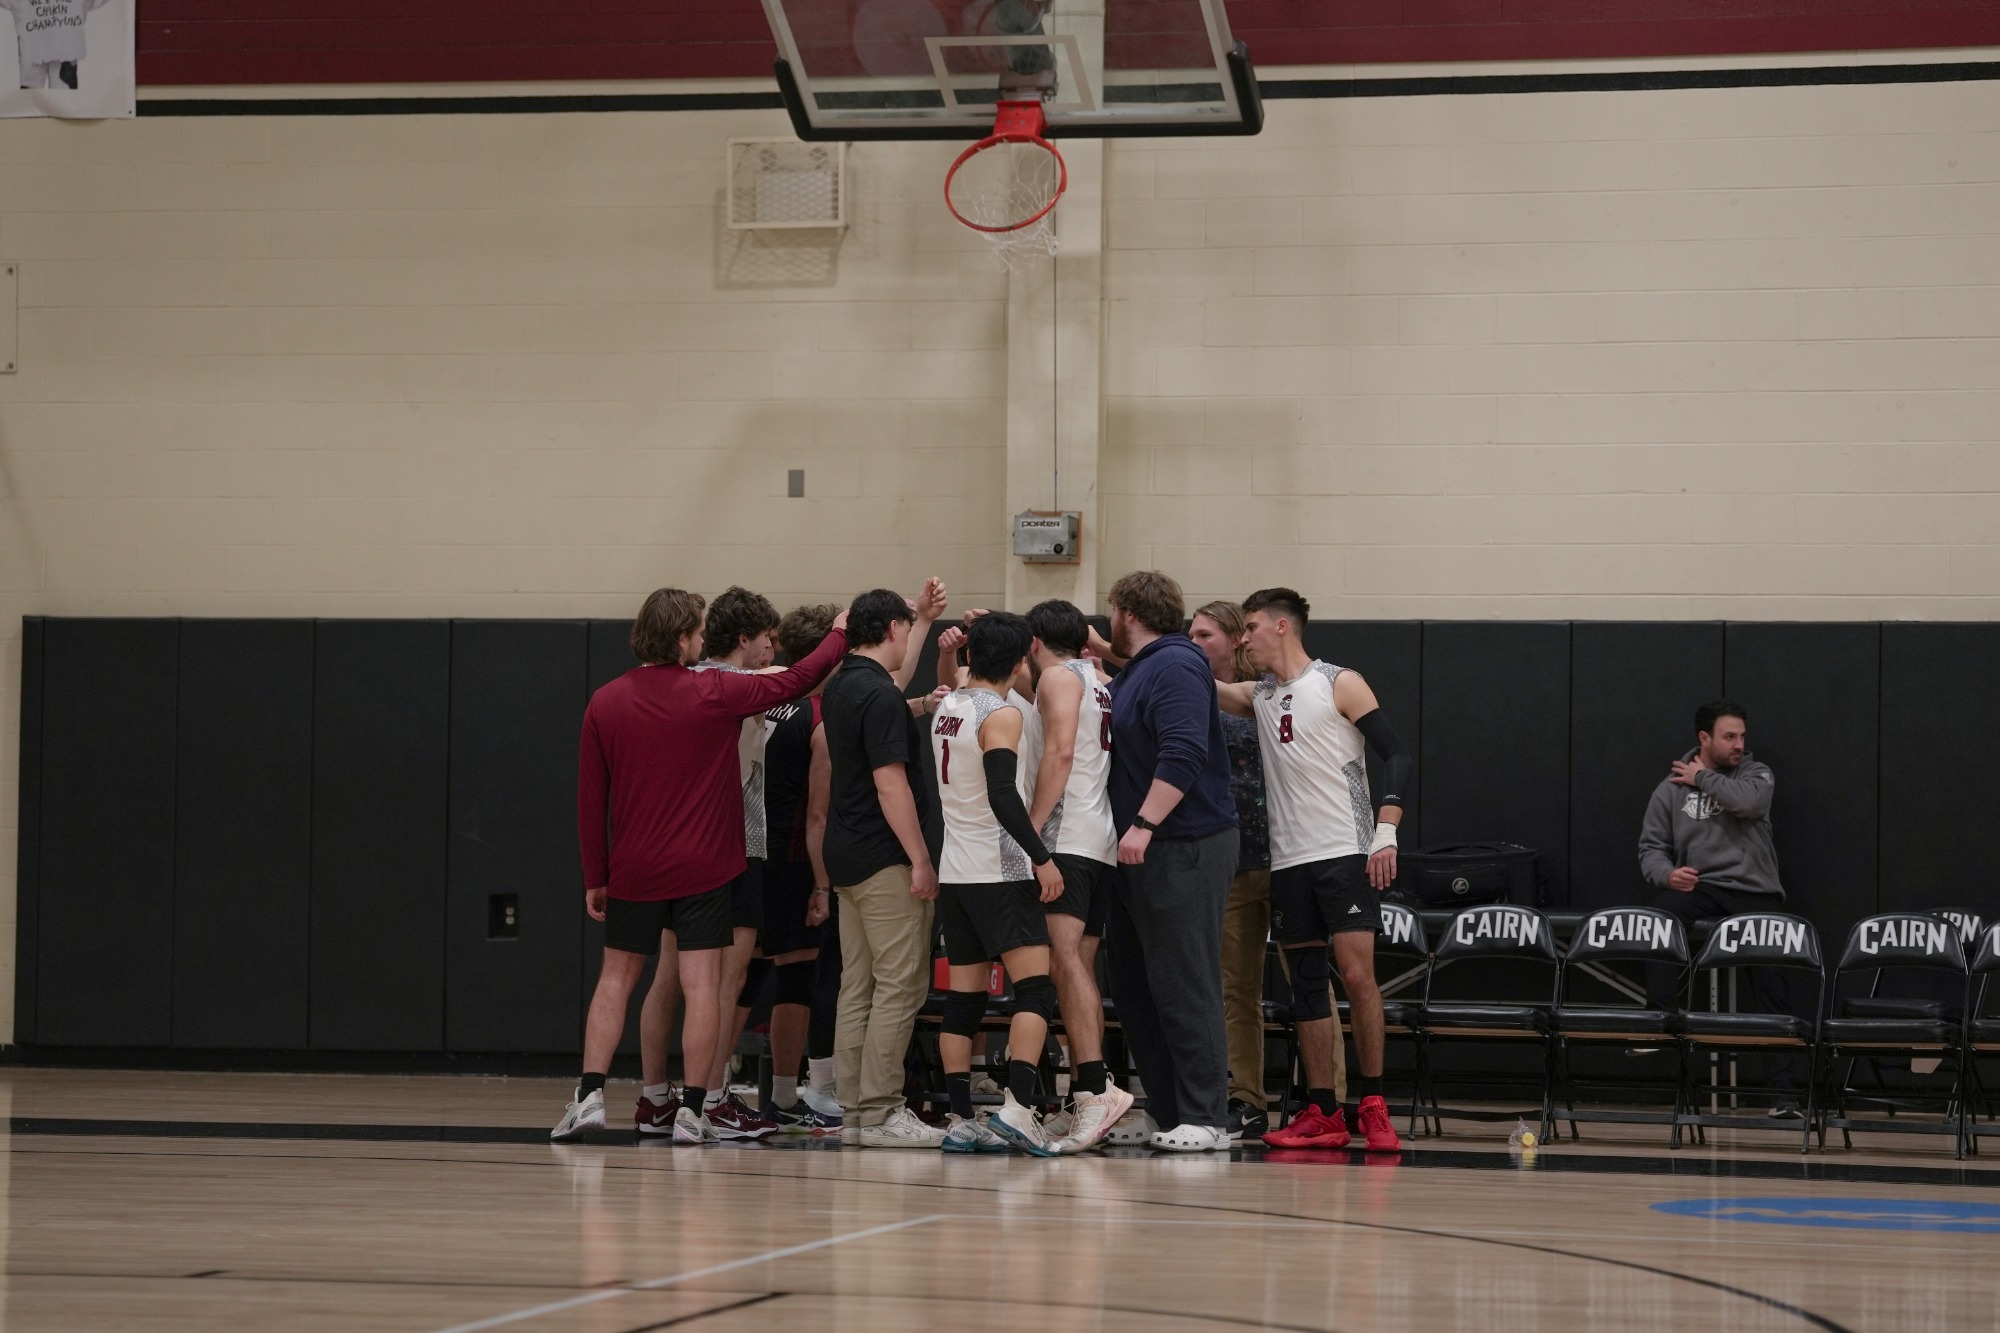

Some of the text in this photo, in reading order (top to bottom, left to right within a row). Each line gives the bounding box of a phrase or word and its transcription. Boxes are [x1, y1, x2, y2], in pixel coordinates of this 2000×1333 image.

[934, 715, 965, 737] CAIRN
[1279, 714, 1294, 743] 8
[941, 738, 950, 785] 1
[1455, 911, 1540, 947] CAIRN
[1587, 914, 1673, 949] CAIRN
[1719, 919, 1806, 954] CAIRN
[1859, 919, 1948, 956] CAIRN
